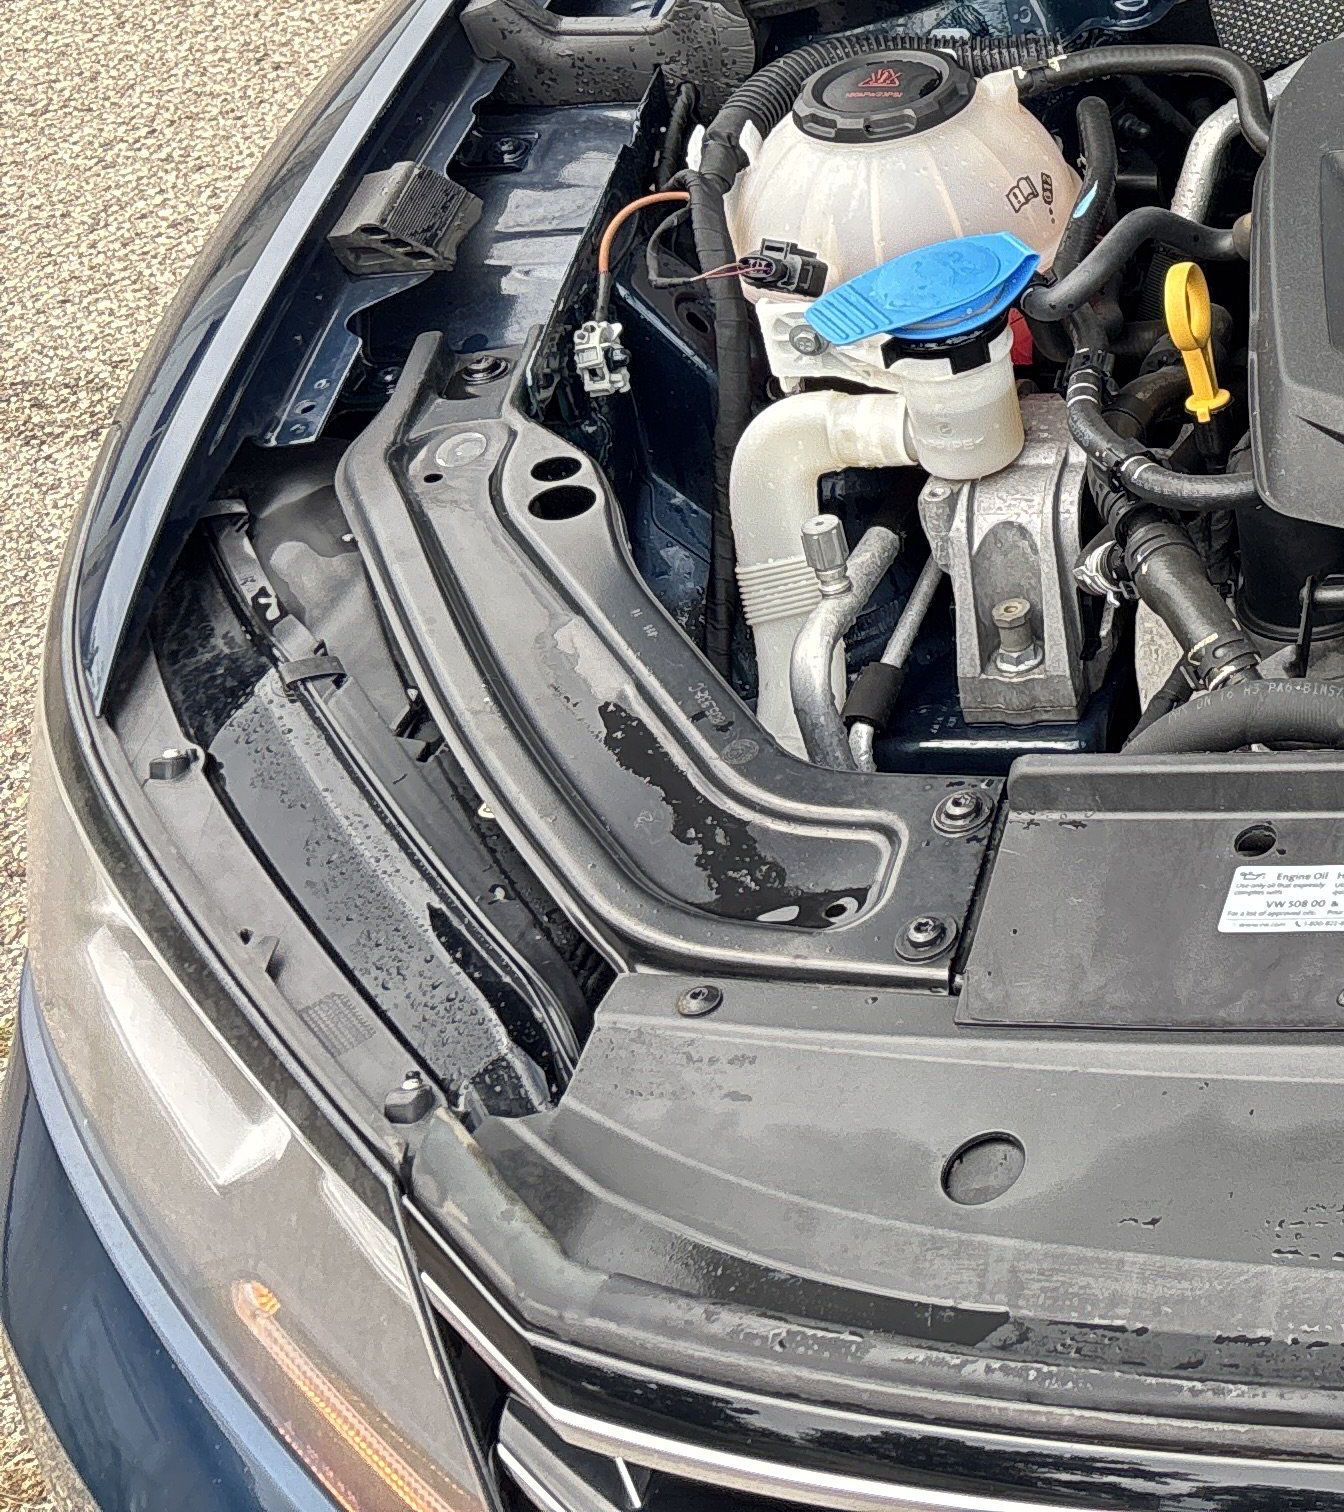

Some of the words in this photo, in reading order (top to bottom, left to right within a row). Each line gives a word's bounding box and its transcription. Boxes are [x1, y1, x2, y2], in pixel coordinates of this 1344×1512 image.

[1276, 872, 1311, 882] Engine
[1313, 872, 1329, 880] Oil
[1266, 900, 1286, 908] VW
[1288, 900, 1308, 908] 508
[1310, 899, 1326, 907] 00
